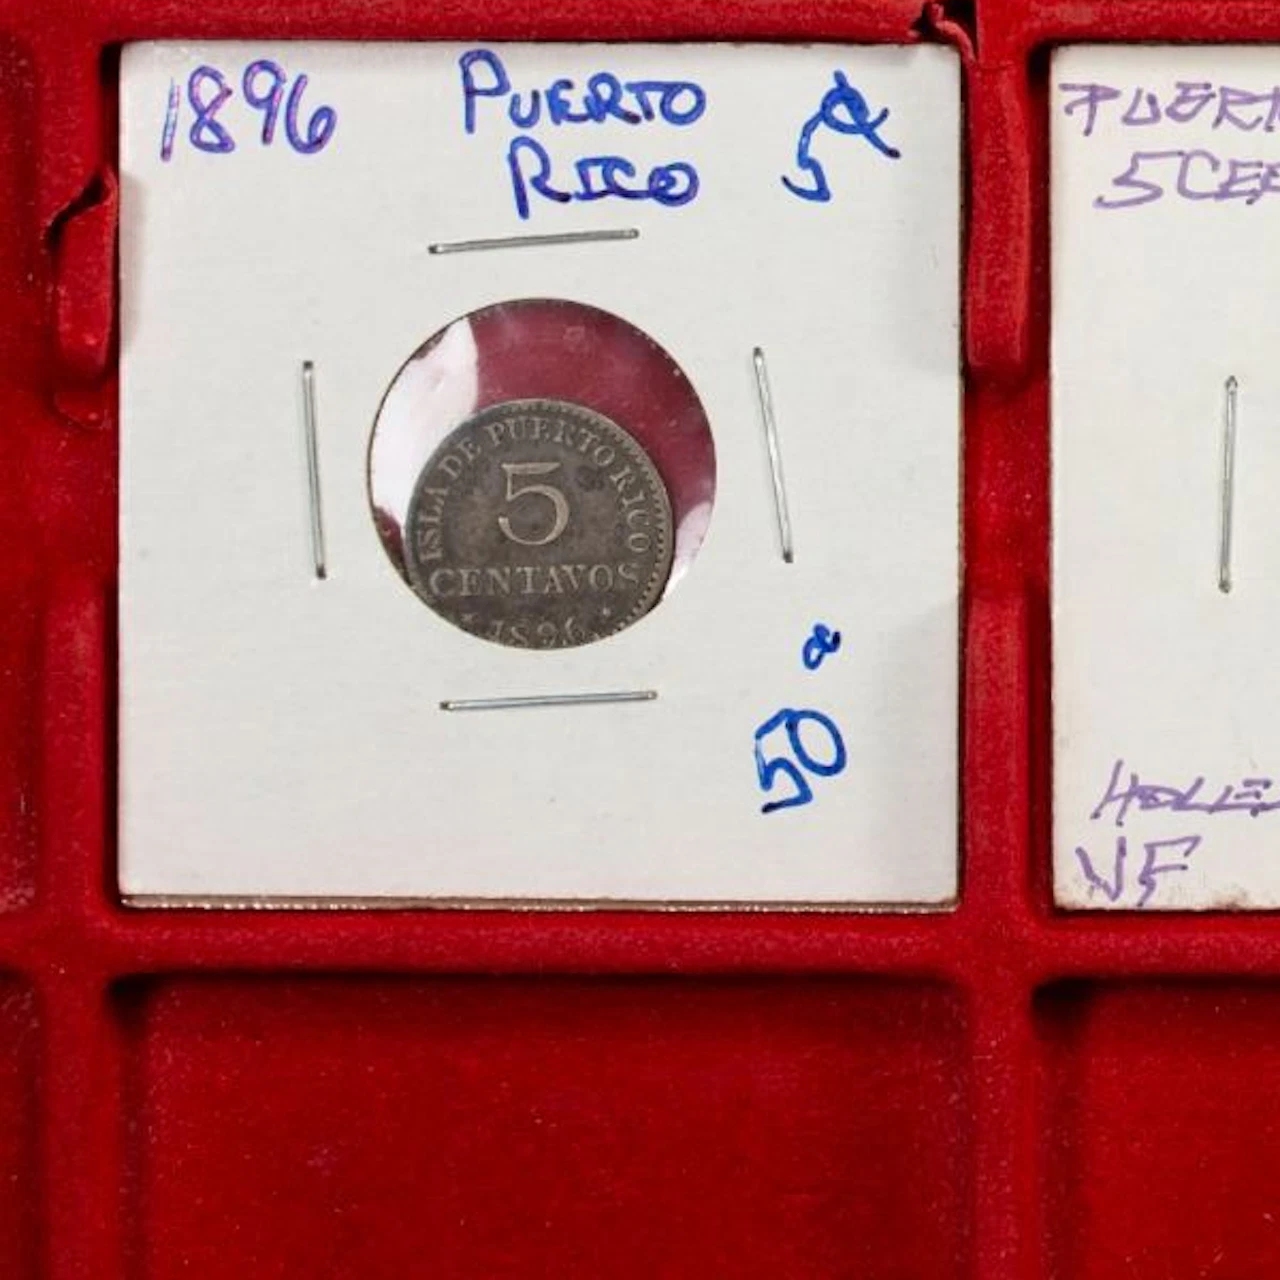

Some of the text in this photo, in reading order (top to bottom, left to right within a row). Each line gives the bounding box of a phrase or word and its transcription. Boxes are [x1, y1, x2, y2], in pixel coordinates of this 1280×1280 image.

[159, 59, 338, 162] 1896
[497, 461, 571, 546] 5
[428, 563, 641, 598] CENTAVOS
